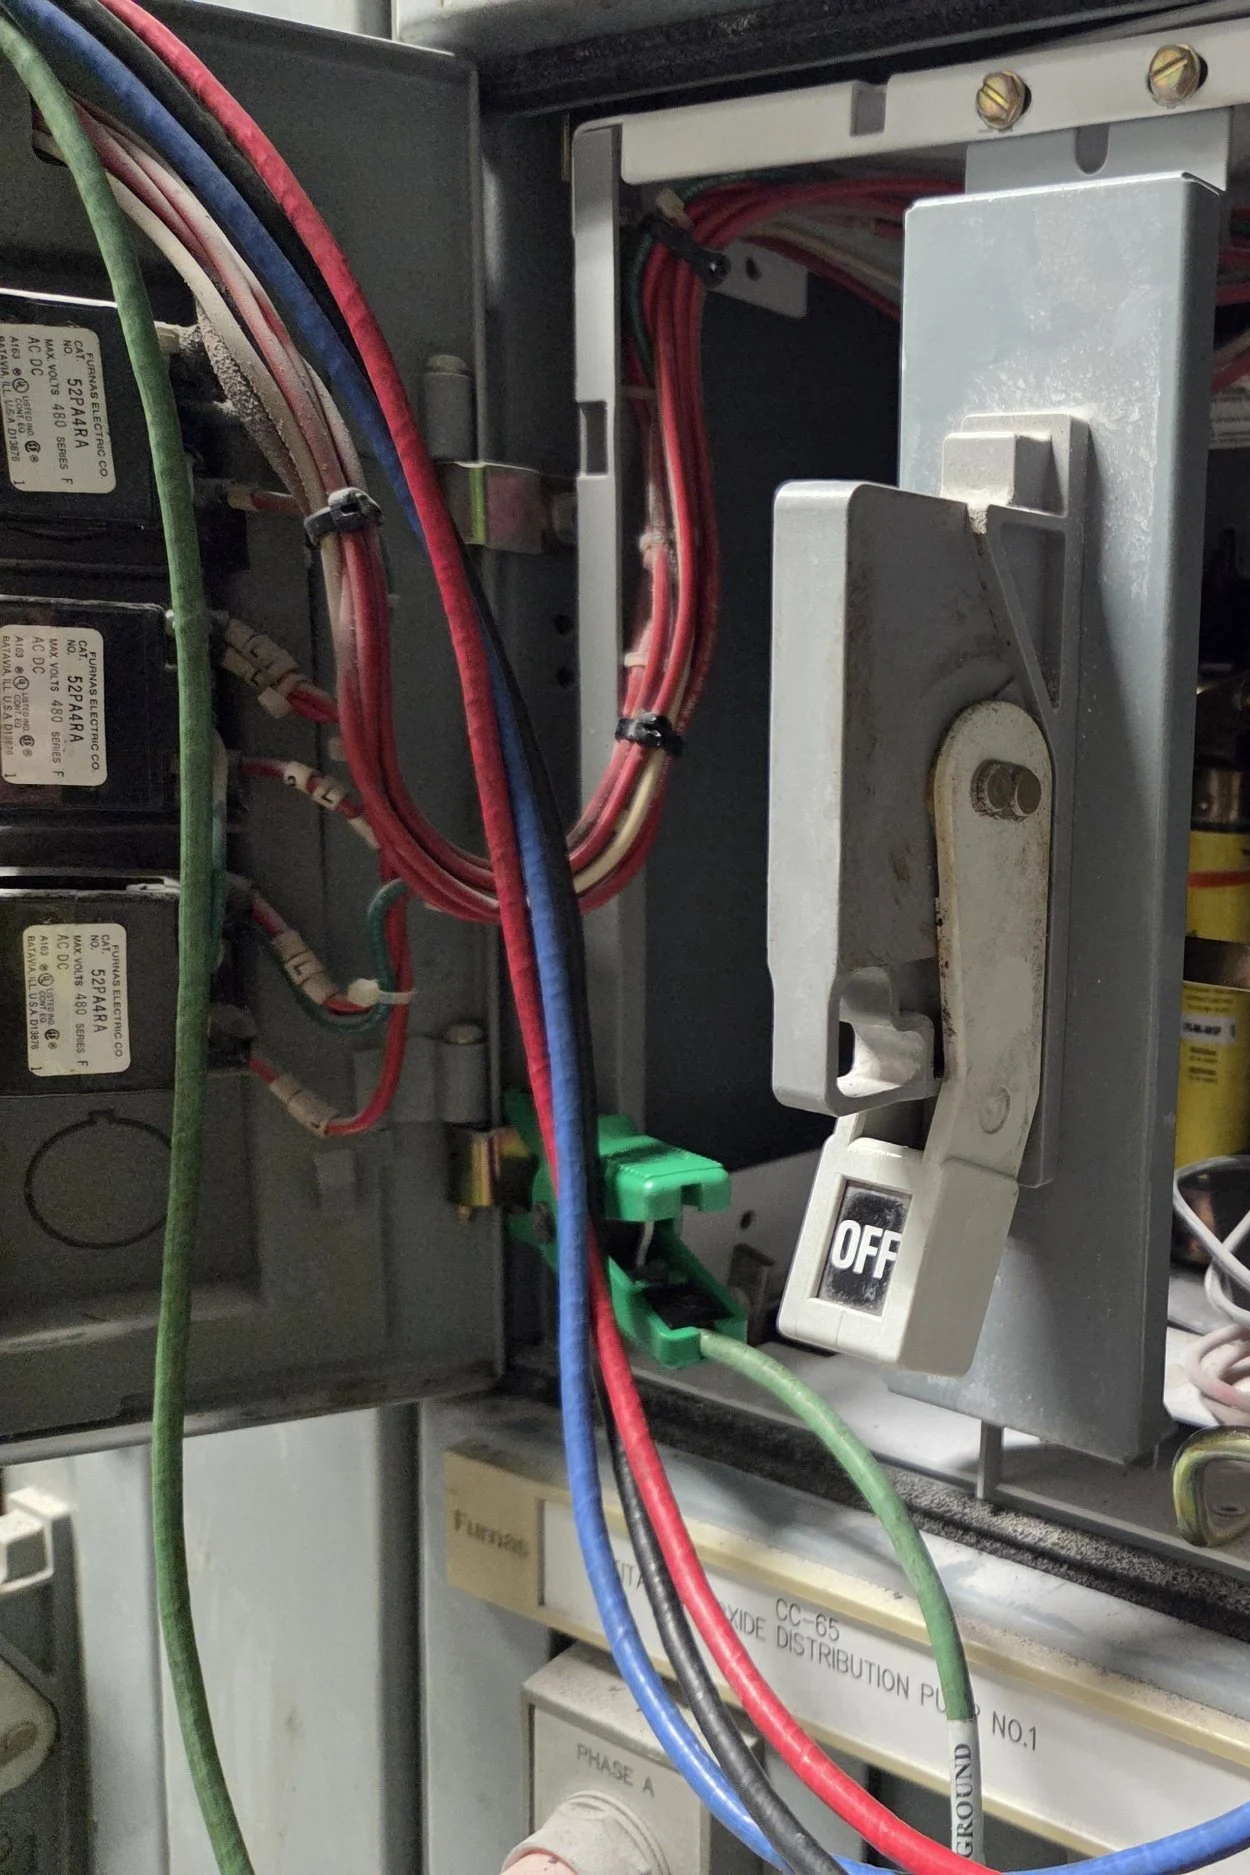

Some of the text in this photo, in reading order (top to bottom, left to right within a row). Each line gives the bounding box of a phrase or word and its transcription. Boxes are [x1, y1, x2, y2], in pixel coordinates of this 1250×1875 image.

[28, 336, 43, 376] AC DC
[48, 365, 59, 395] VOLTS
[52, 404, 66, 428] 480
[67, 379, 89, 448] 52PA4RA
[86, 353, 98, 399] FURNAS
[92, 402, 105, 457] ELECTRIC
[56, 437, 68, 469] SERIES
[32, 636, 46, 674] AC DC
[89, 651, 97, 696] FURNAS
[50, 662, 60, 692] VOLTS
[51, 700, 63, 723] 480
[67, 676, 85, 743] 52PA4RA
[90, 699, 99, 751] ELECTRIC
[51, 732, 62, 764] SERIES
[57, 935, 69, 970] AC DC
[74, 957, 84, 986] VOLTS
[111, 945, 120, 986] FURNAS
[75, 994, 88, 1016] 480
[91, 969, 108, 1033] 52PA4RA
[112, 990, 122, 1040] ELECTRIC
[76, 1023, 86, 1054] SERIES
[831, 1220, 902, 1279] OFF
[454, 1508, 528, 1557] Furnas
[776, 1598, 840, 1641] CC-65
[776, 1626, 1037, 1751] DISTRIBUTION NO.1
[577, 1742, 655, 1798] PHASE A
[954, 1743, 974, 1858] GROUND
